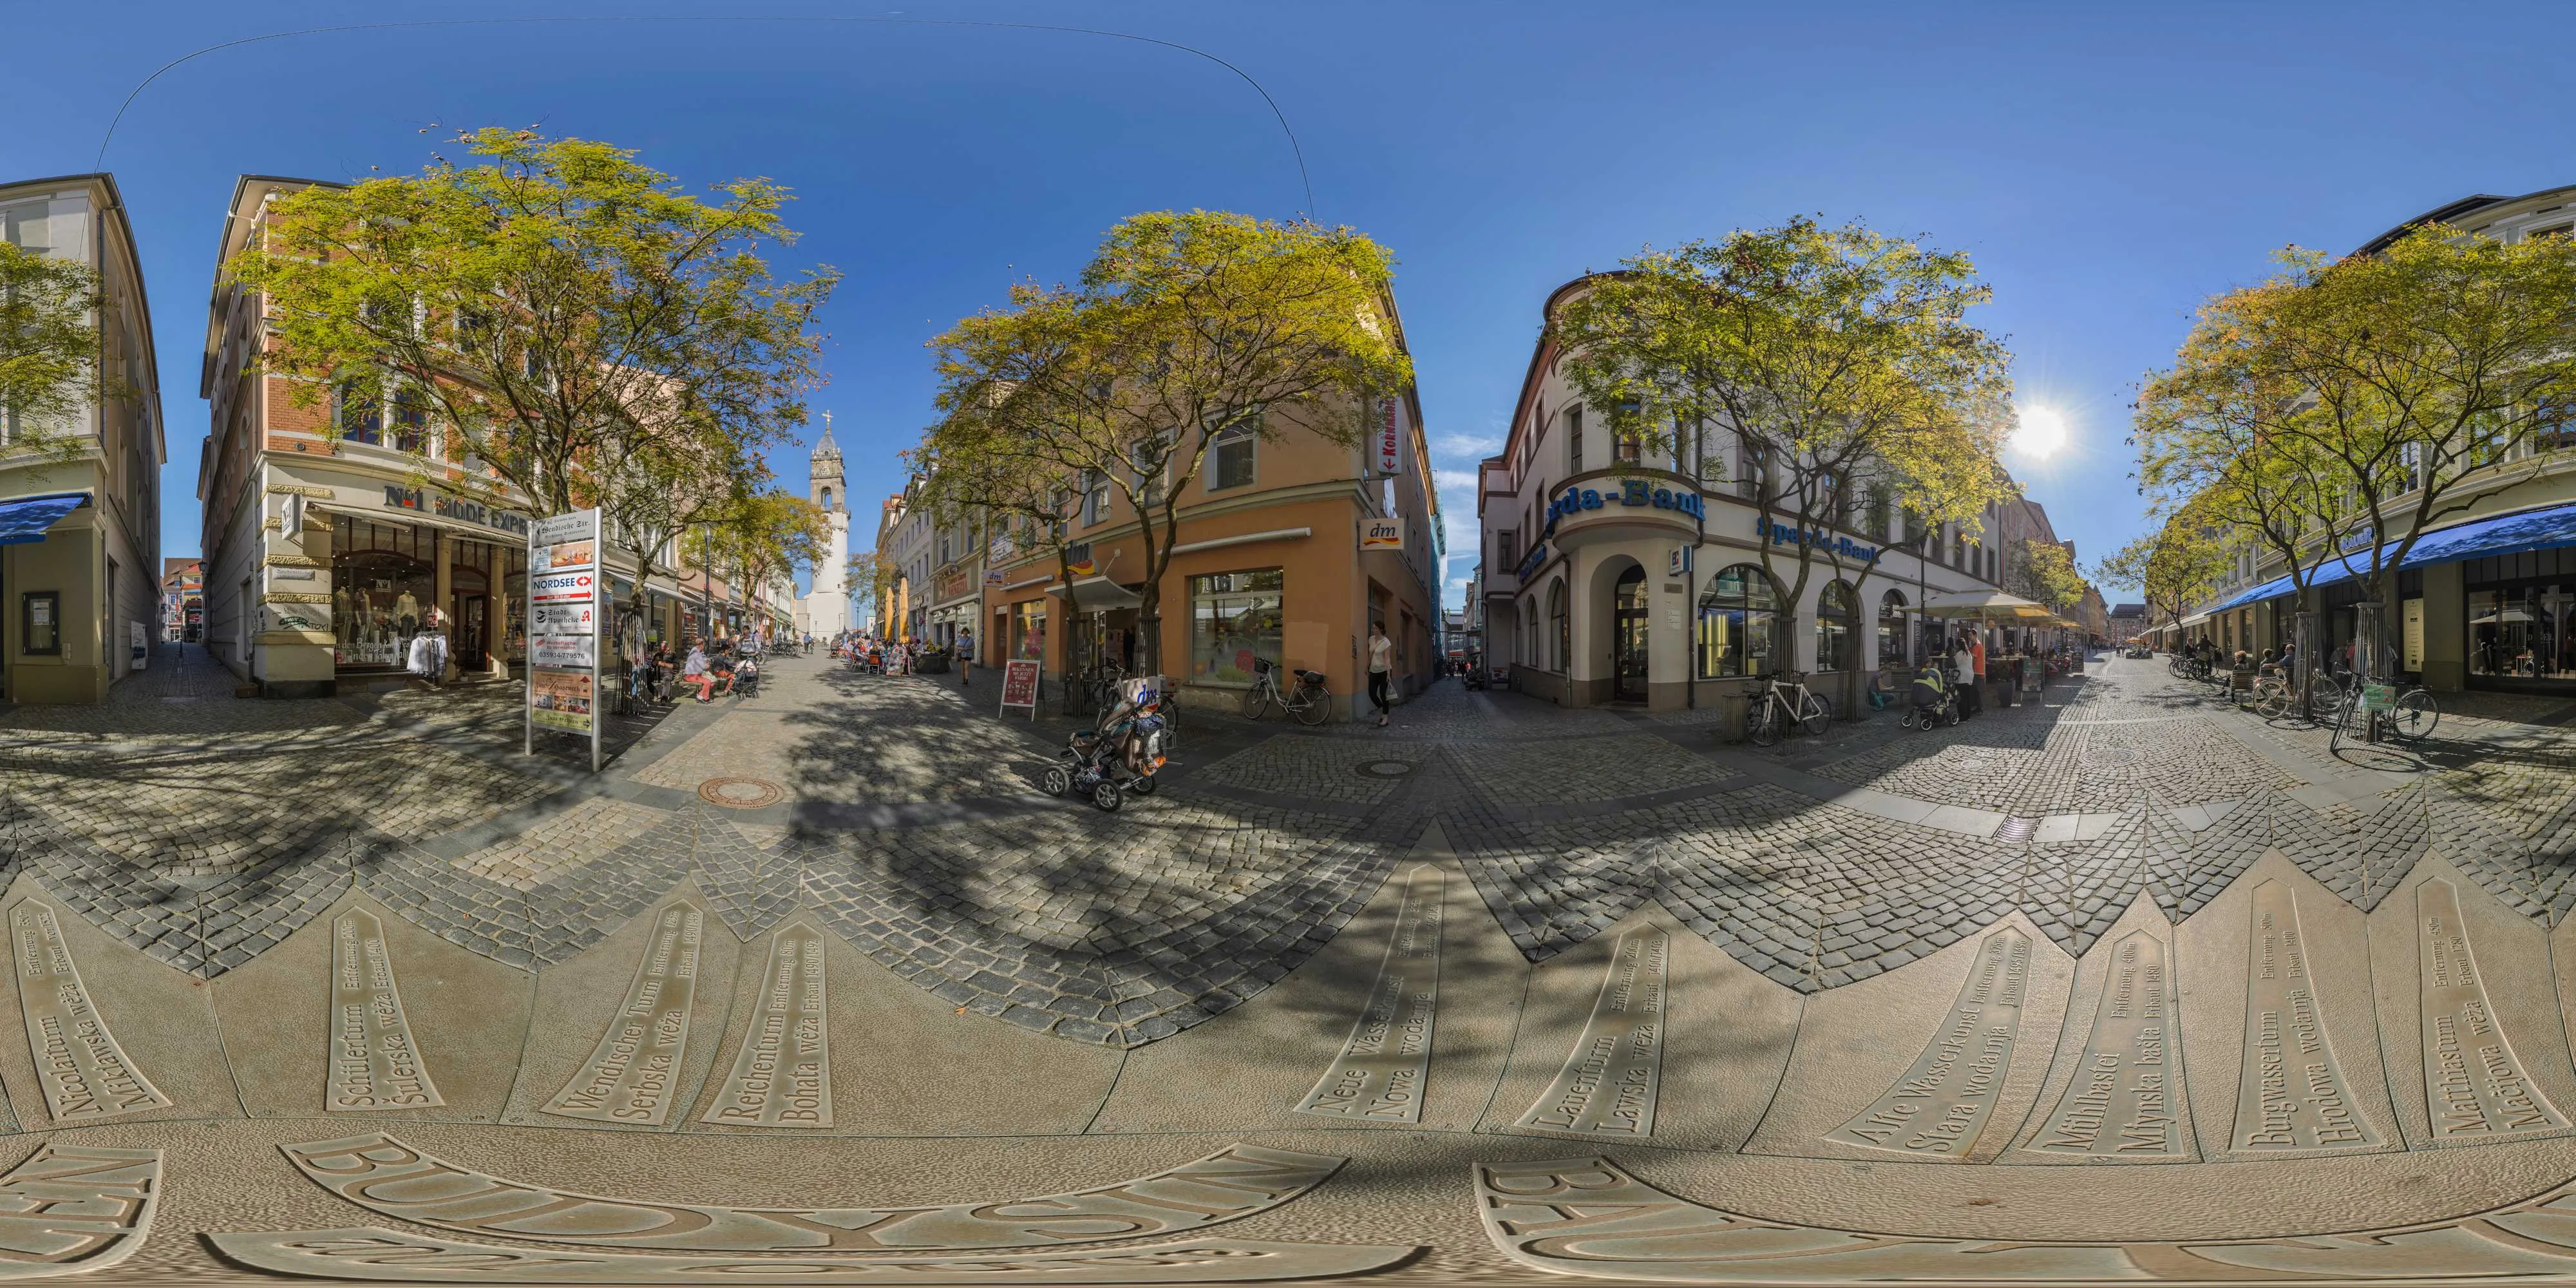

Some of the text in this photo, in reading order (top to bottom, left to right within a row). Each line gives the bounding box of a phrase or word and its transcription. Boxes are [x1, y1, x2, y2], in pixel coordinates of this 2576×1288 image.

[542, 523, 574, 533] Wendische
[1370, 523, 1396, 537] dm
[534, 578, 575, 590] NORDSEE
[989, 572, 1001, 580] dm
[539, 651, 585, 659] 035934-779576
[1137, 685, 1157, 705] dm
[38, 912, 53, 928] 1522
[46, 927, 57, 940] vor
[366, 938, 382, 956] 1400
[2450, 936, 2465, 953] 1280
[24, 931, 42, 976] Entfernung
[52, 946, 70, 974] Erbaut
[374, 958, 390, 989] Erbaut
[2146, 965, 2161, 983] 1480
[2432, 940, 2449, 989] Entfernung
[2457, 958, 2474, 987] Erbaut
[337, 919, 375, 1106] Schülerturm Entfernung 200m
[559, 1021, 645, 1110] Wendischer
[625, 980, 660, 1016] Turm
[650, 929, 678, 976] Entfernung
[612, 912, 699, 1120] Serbska wěža Erbaut 1490/1491
[718, 939, 796, 1121] Reichenturm Entfernung 80m
[779, 940, 820, 1123] Bohata wěža Erbaut 1490/1492
[1309, 1069, 1370, 1113] Neue
[1347, 976, 1403, 1056] Wasserkunst
[1397, 916, 1420, 959] Entfernung
[1365, 1069, 1416, 1117] Nowa
[1401, 992, 1434, 1056] wodarnja
[1423, 934, 1435, 959] Erbaut
[2145, 987, 2161, 1019] Erbaut
[2247, 911, 2298, 1146] Burgwasserturm Entfernung 500m
[1531, 939, 1640, 1128] Lauenturm Entfernung 200m
[1593, 940, 1665, 1132] Lawska wěža Erbaut 1400/1403
[1850, 936, 2005, 1144] Alte Wasserkunst Entfernung 375m
[1905, 938, 2027, 1152] Stara wodarnja Erbaut 1495/1496
[2042, 942, 2136, 1150] Mühlbastei Entfernung 400m
[2133, 1027, 2163, 1066] bašta
[2283, 931, 2367, 1144] Hrodowa wodarnja Erbaut 1400
[39, 1016, 104, 1117] Nicolaiturm
[382, 1033, 429, 1104] Šulerska
[2436, 1015, 2492, 1134] Matthiasturm
[2479, 1045, 2552, 1130] Mačijowa
